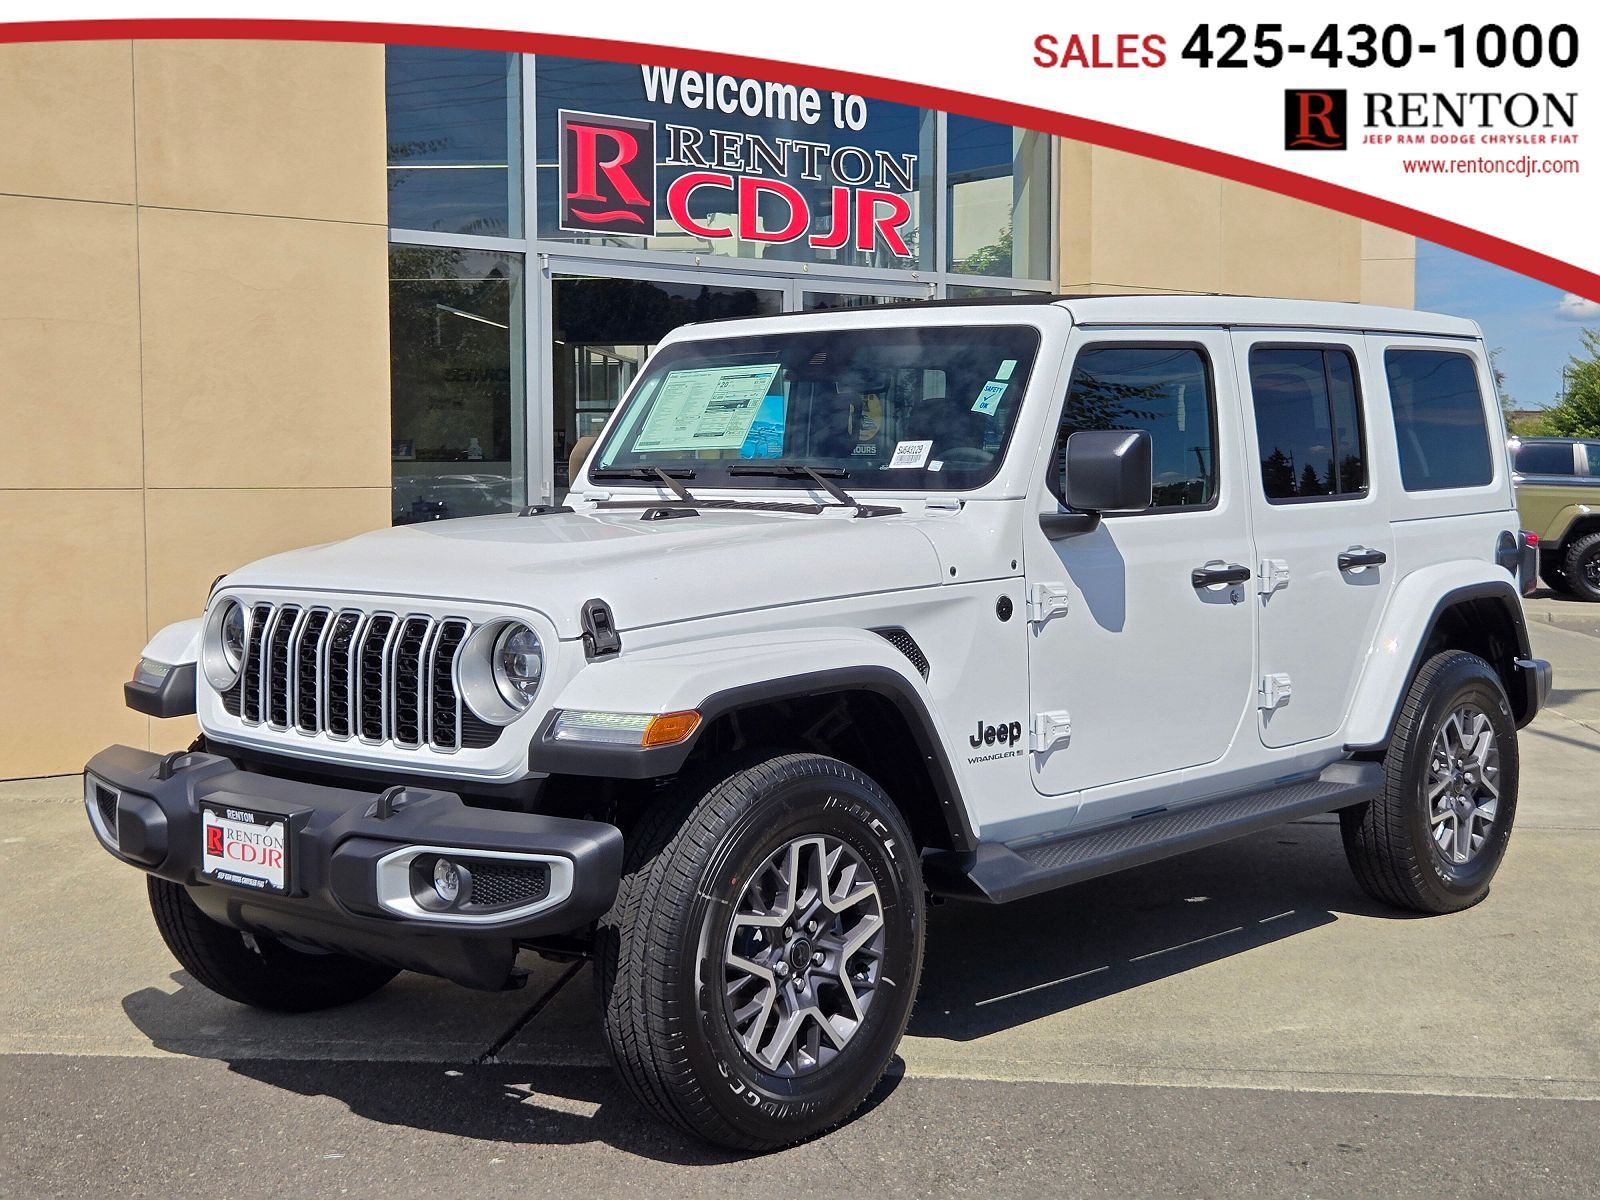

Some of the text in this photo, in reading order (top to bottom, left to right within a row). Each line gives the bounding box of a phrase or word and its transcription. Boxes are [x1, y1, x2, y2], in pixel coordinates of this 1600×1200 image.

[641, 64, 868, 131] Welcome to
[566, 123, 651, 208] R
[666, 124, 917, 190] RENTON
[666, 172, 914, 259] CDJR
[984, 385, 1004, 394] SAFETY
[969, 720, 1022, 749] Jeep
[968, 750, 1015, 764] WRANGLER
[227, 809, 254, 823] RENTON
[227, 828, 284, 849] RENTON
[226, 841, 282, 868] CDJR
